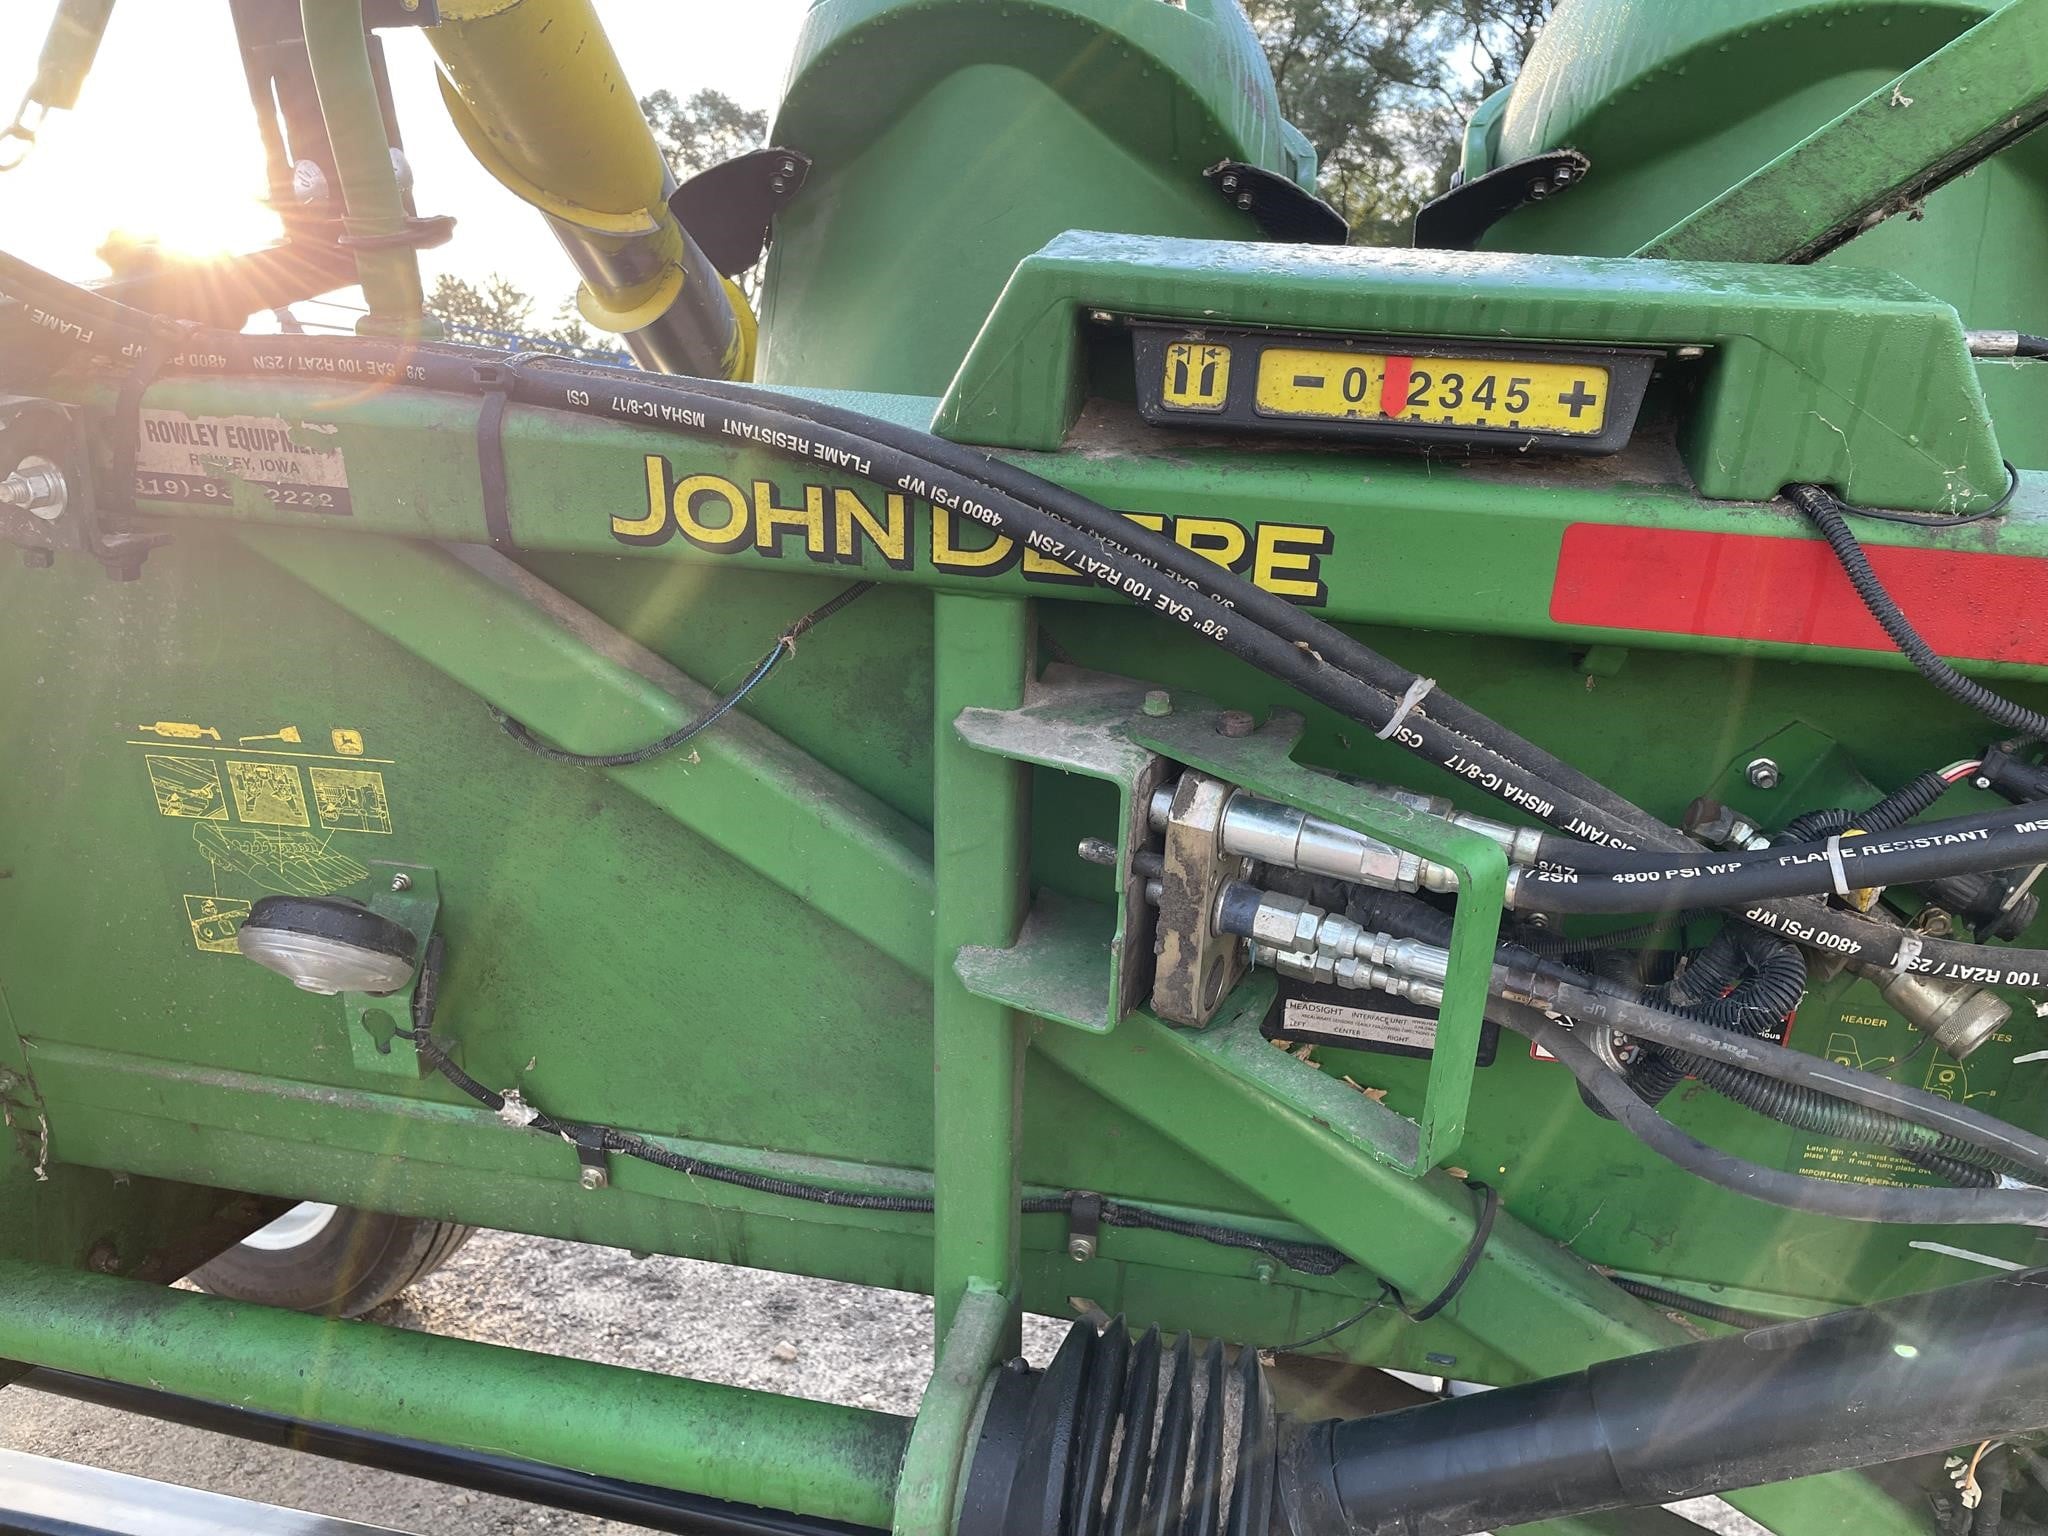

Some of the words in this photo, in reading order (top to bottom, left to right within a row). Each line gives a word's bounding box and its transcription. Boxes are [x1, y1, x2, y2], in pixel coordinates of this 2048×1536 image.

[31, 308, 94, 343] FLAME
[190, 353, 226, 368] 4800
[253, 355, 284, 370] 2SN
[298, 356, 334, 371] R2AT
[338, 359, 361, 374] 100
[367, 360, 395, 378] SAE
[567, 388, 590, 406] CSI
[612, 396, 658, 419] IC-8/17
[661, 405, 706, 428] MSHA
[144, 419, 219, 448] ROWLEY
[722, 417, 809, 456] RESISTANT
[260, 458, 300, 474] IOWA
[814, 442, 872, 475] FLAME
[897, 473, 926, 497] WP
[930, 486, 960, 509] PSI
[610, 455, 914, 570] JOHN
[962, 499, 1003, 528] 4800
[1027, 528, 1066, 558] 2SN
[1074, 555, 1123, 586] R2AT
[1123, 576, 1153, 601] 100
[1154, 593, 1194, 623] SAE
[1193, 618, 1229, 642] 3/8"
[1392, 723, 1424, 748] CSI
[1443, 752, 1505, 792] IC-8/17
[1502, 781, 1555, 819] MSHA
[1537, 870, 1578, 884] 2SN
[1612, 869, 1660, 884] 4800
[1665, 866, 1701, 880] PSI
[1706, 860, 1743, 876] WP
[1863, 828, 1989, 857] RESISTANT
[1745, 906, 1777, 929] WP
[1781, 918, 1814, 940] PSI
[1815, 930, 1862, 954] 4800
[1945, 963, 2001, 984] R2AT
[2006, 970, 2041, 987] 100
[1289, 1002, 1344, 1017] HEADSIGHT
[1351, 1012, 1390, 1024] INTERFACE
[1391, 1018, 1408, 1026] UNIT
[1840, 1014, 1889, 1028] HEADER
[1333, 1026, 1361, 1036] CENTER
[1387, 1034, 1410, 1043] RIGHT
[1804, 1151, 1824, 1161] plate
[1876, 1162, 1893, 1170] turn
[1895, 1164, 1916, 1173] plate
[1806, 1144, 1829, 1153] Latch
[1831, 1148, 1844, 1156] pin
[1866, 1153, 1888, 1162] must
